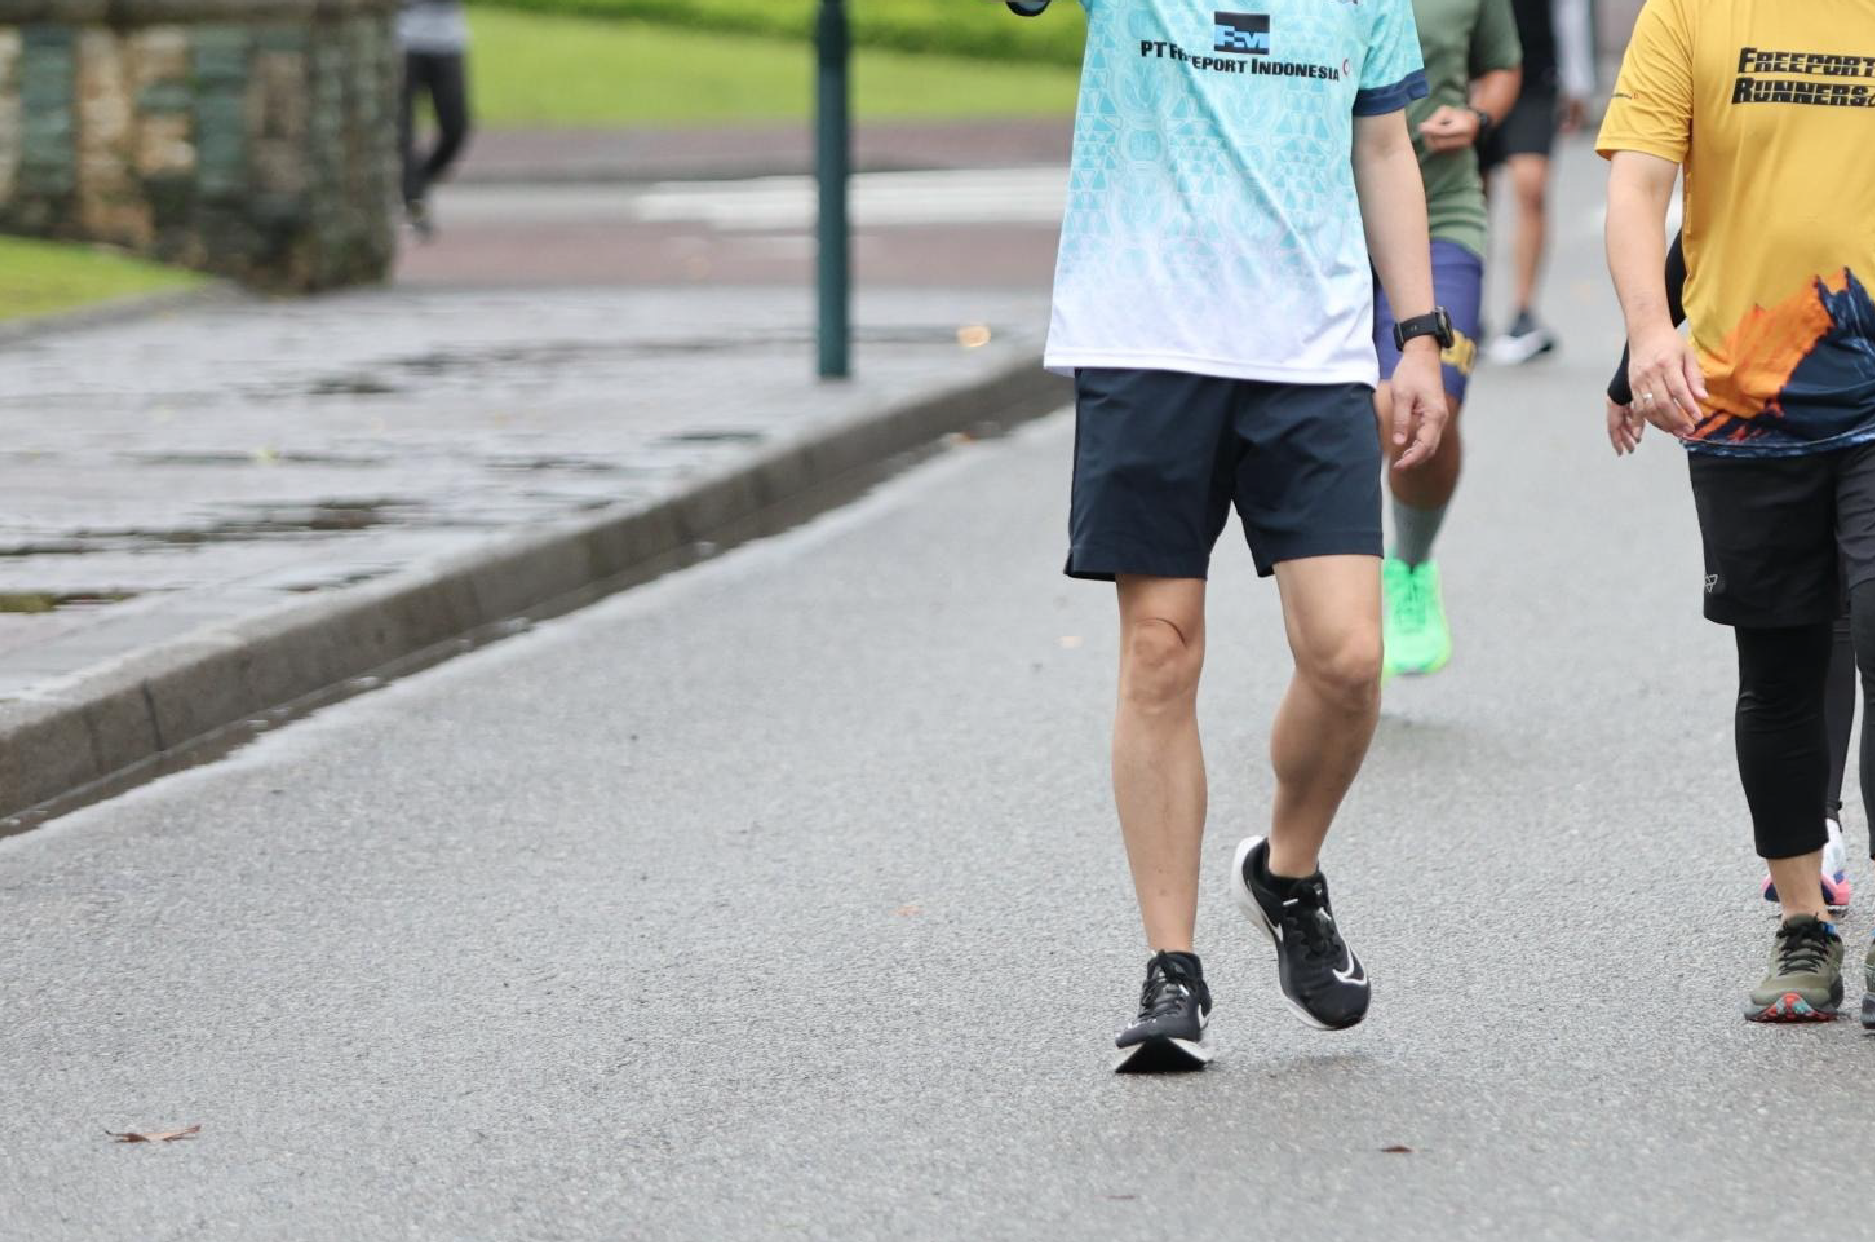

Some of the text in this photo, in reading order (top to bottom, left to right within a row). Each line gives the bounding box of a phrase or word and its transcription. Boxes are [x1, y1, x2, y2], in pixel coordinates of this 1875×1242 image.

[1141, 39, 1168, 58] PT
[1251, 58, 1341, 82] INDONESIA
[1731, 77, 1869, 106] RUNNERS
